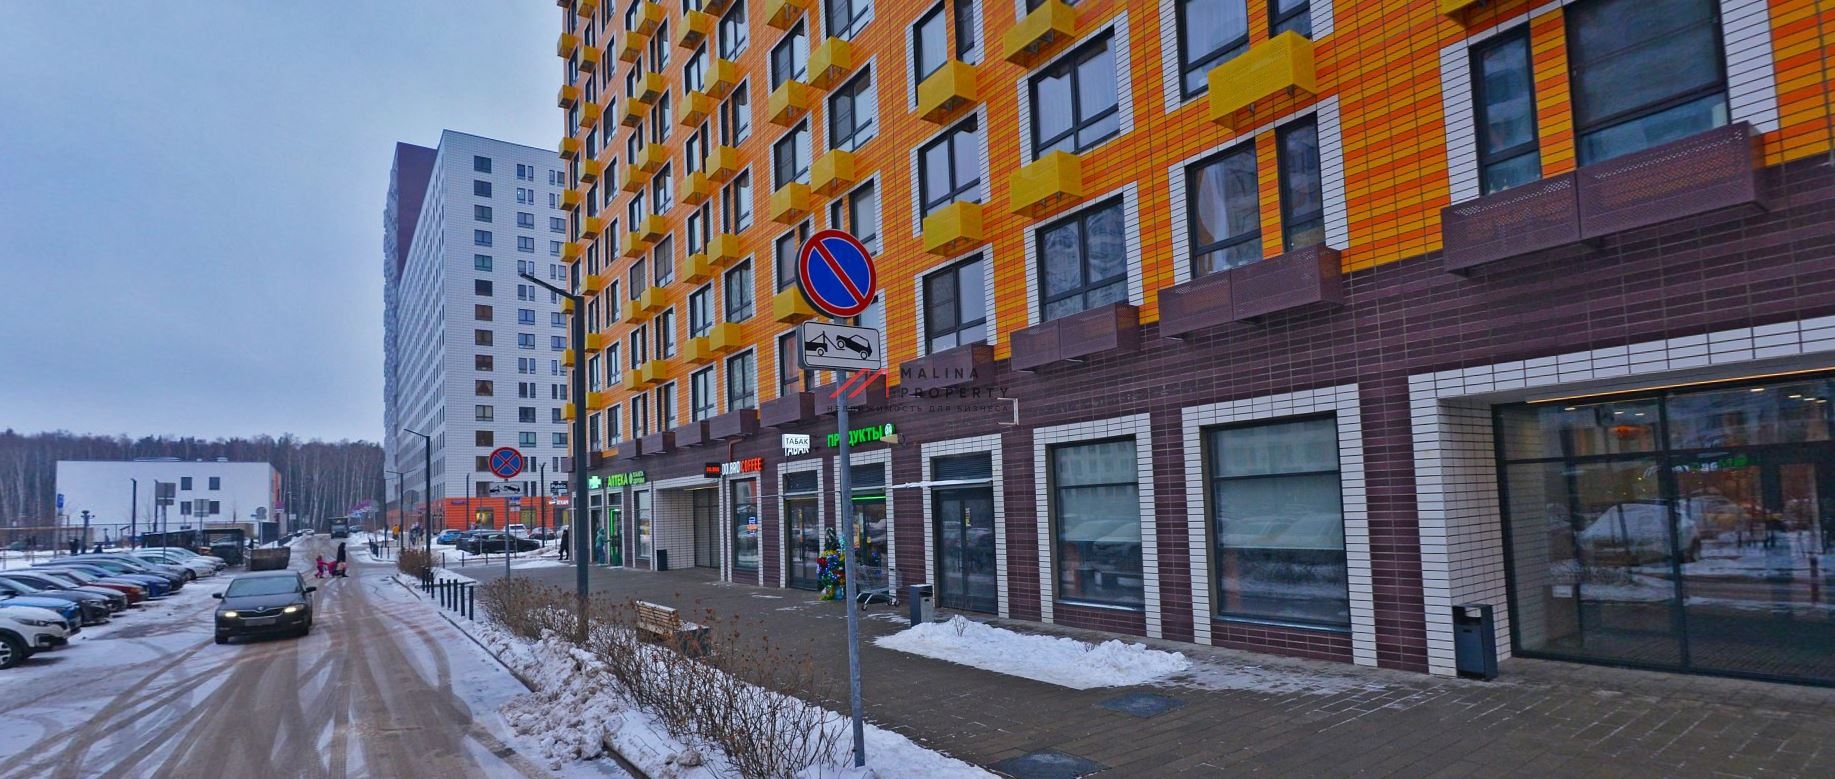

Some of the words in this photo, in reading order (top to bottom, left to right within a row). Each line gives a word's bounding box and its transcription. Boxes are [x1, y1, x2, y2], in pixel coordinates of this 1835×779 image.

[785, 437, 809, 445] ТАБАК
[827, 425, 883, 447] ПРДУКТЫ
[741, 457, 762, 473] COFFEE
[607, 473, 628, 487] АПТЕКА
